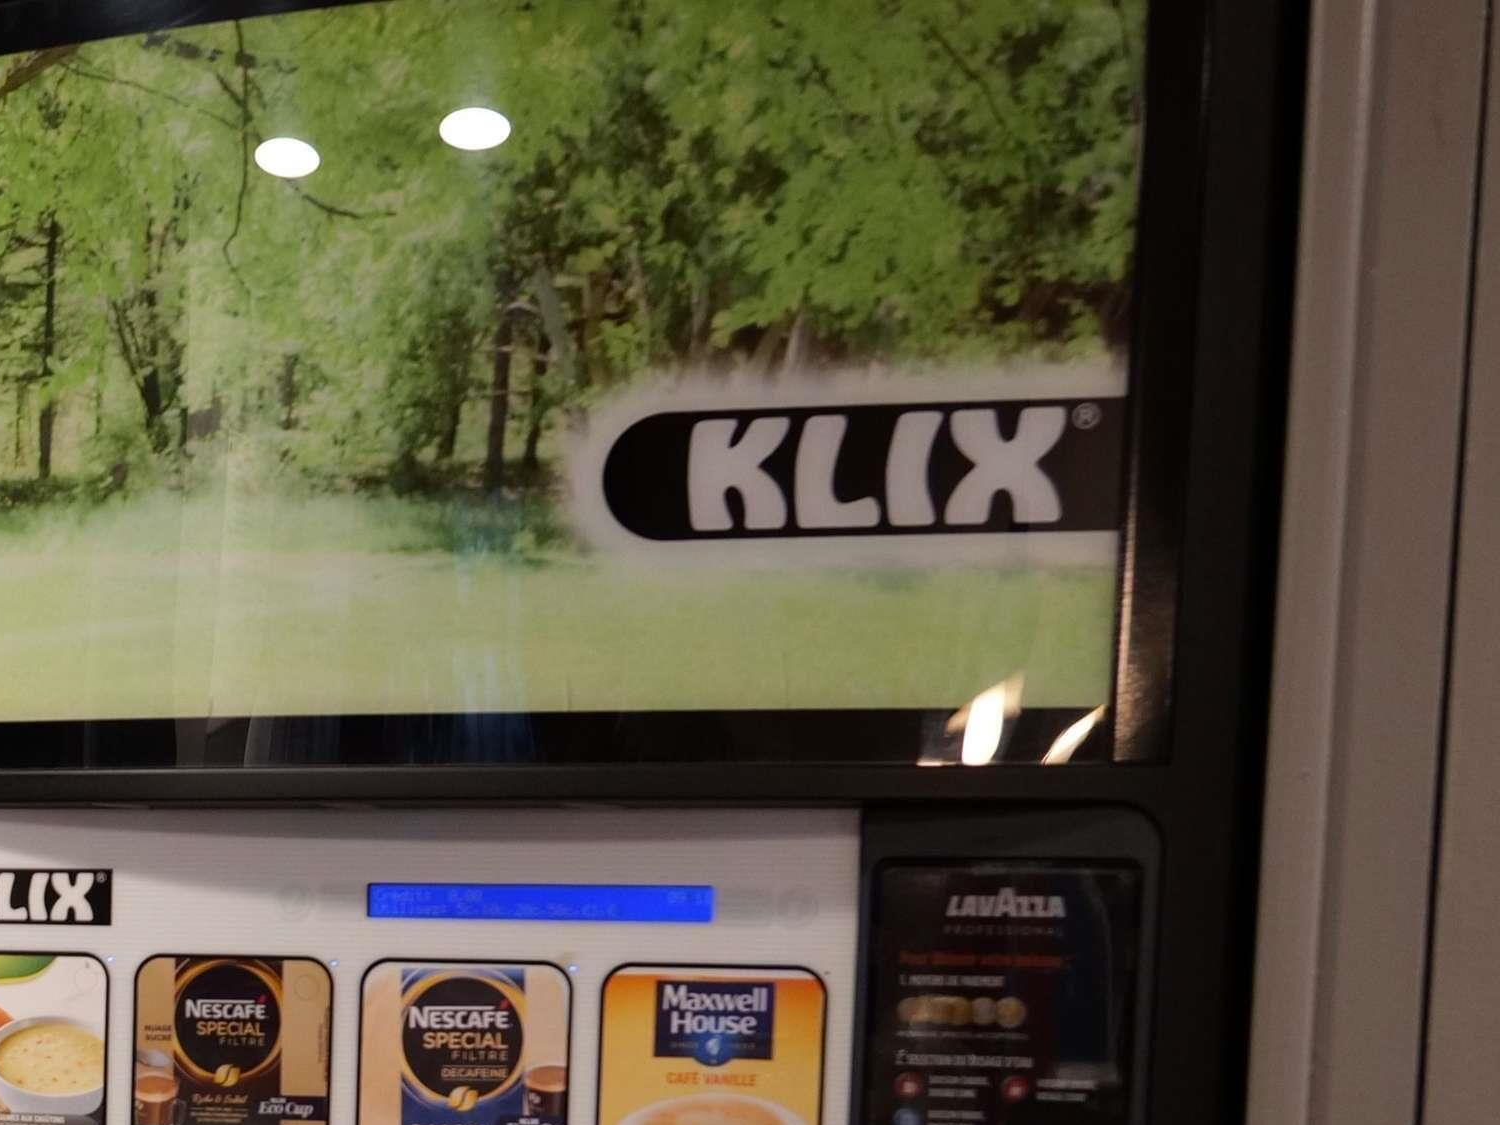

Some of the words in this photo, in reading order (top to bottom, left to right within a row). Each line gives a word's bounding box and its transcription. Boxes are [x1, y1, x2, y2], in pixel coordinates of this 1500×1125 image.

[687, 406, 1067, 531] KLIX
[662, 984, 768, 1012] Maxwell
[196, 1022, 265, 1036] SPECIAL
[670, 1011, 758, 1034] House
[423, 1032, 508, 1049] SPECIAL
